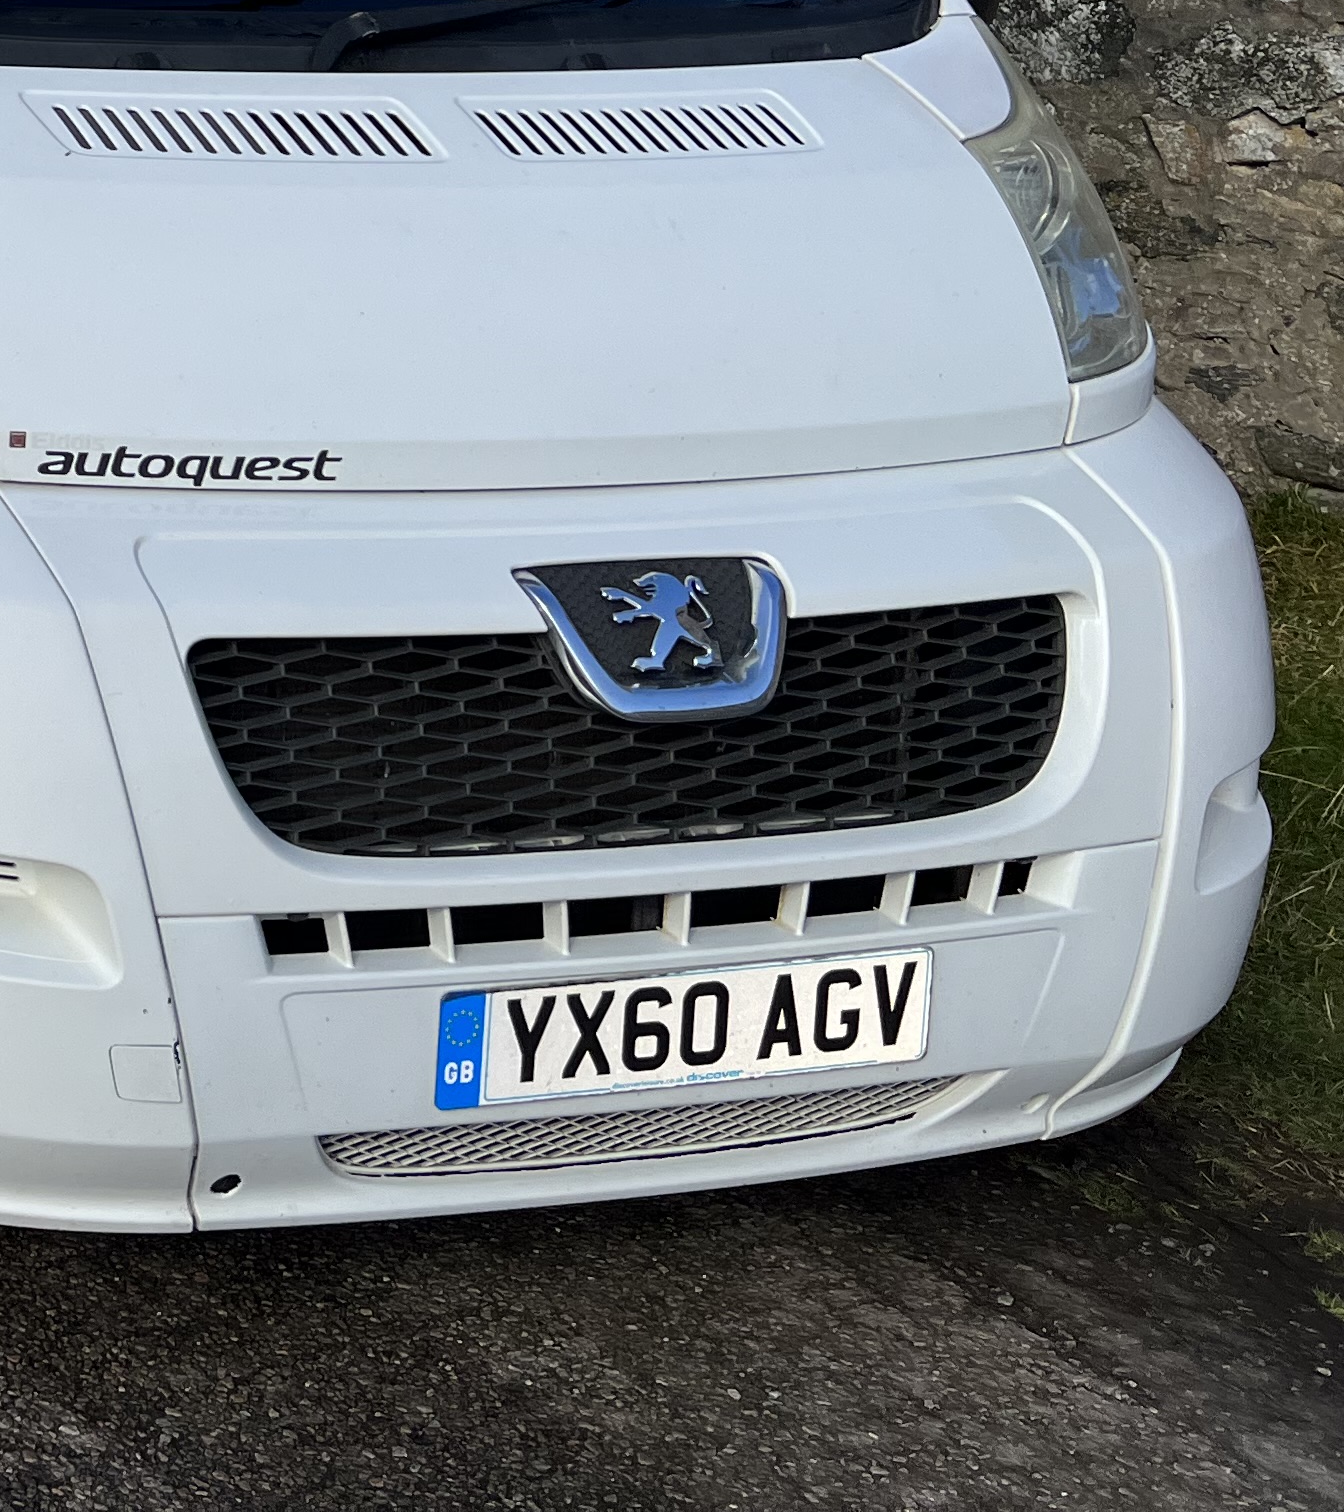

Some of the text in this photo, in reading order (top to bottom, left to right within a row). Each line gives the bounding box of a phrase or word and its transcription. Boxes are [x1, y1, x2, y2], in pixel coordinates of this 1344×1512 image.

[37, 445, 343, 487] autoquest
[506, 961, 919, 1083] YX60 AGV
[444, 1060, 474, 1084] GB
